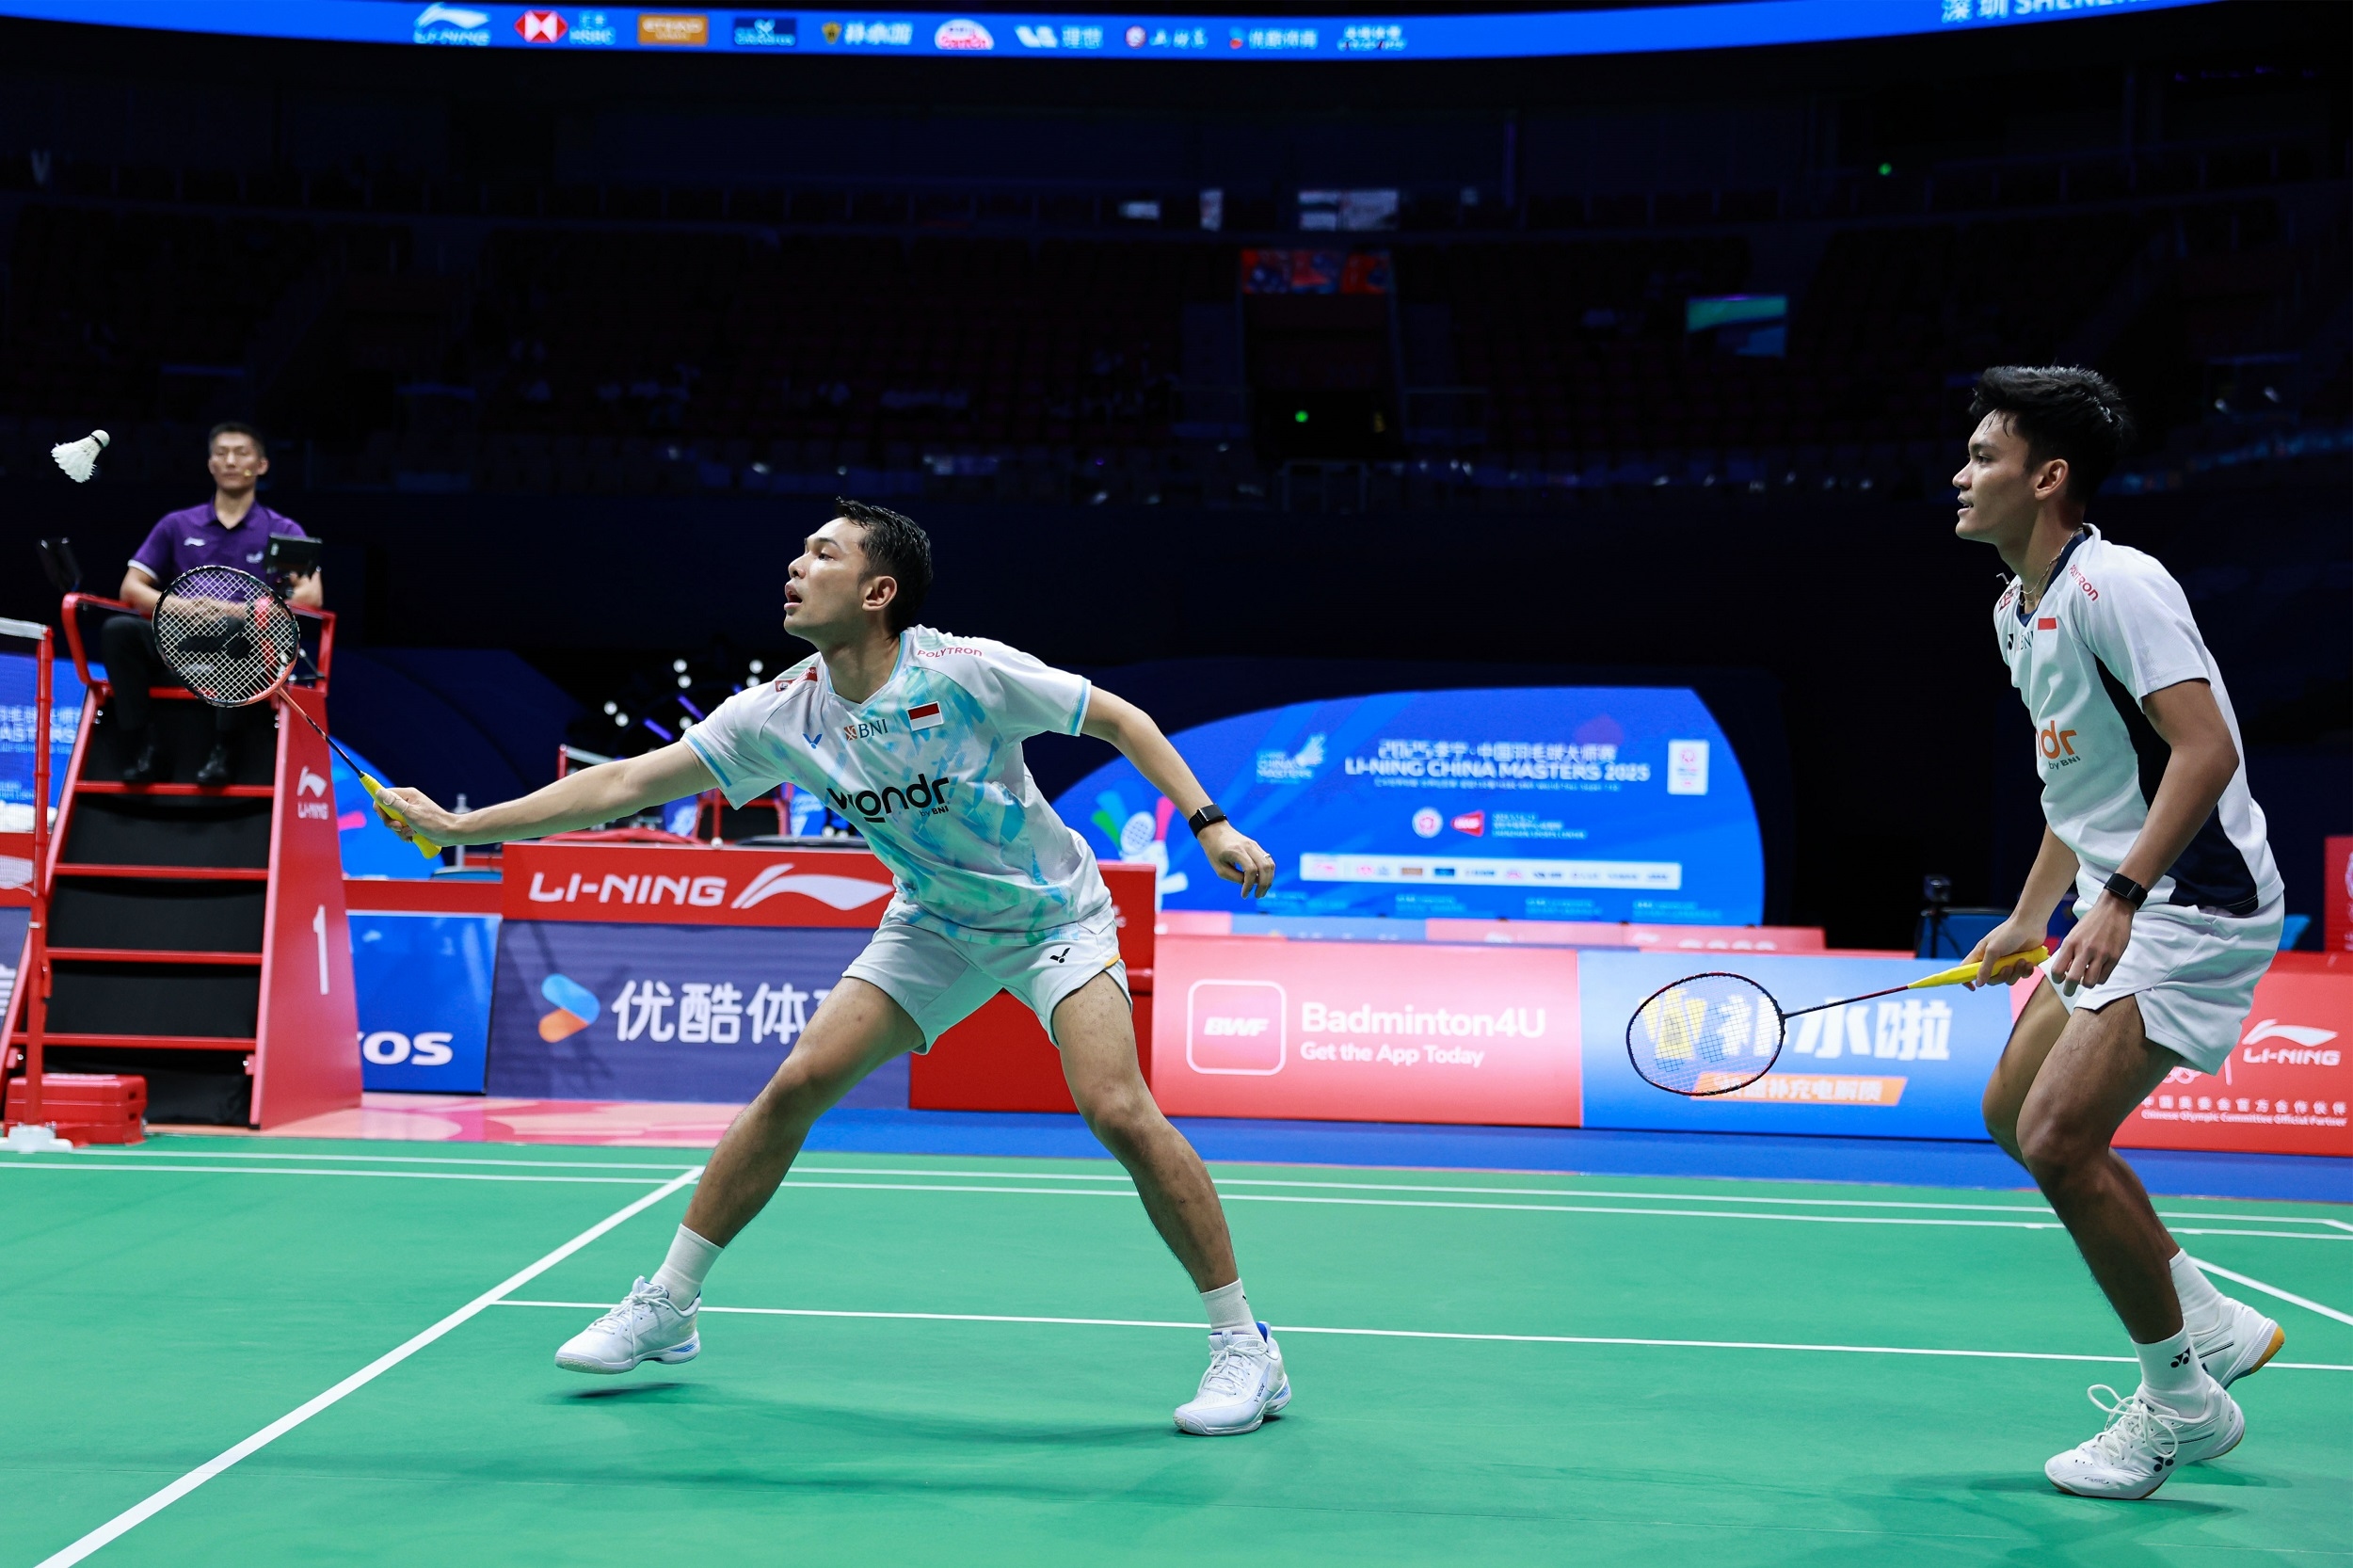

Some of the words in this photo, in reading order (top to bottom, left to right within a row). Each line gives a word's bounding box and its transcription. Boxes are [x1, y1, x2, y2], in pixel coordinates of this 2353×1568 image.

[917, 648, 983, 658] POLYTRON
[858, 719, 888, 738] BNI
[1344, 757, 1426, 776] LI-NING
[1427, 760, 1497, 778] CHINA
[1498, 761, 1602, 780] MASTERS
[1604, 762, 1651, 781] 2025
[2048, 761, 2059, 770] by
[2060, 756, 2081, 766] BNI
[826, 774, 949, 823] wondr
[920, 808, 931, 817] by
[932, 806, 949, 815] BNI
[529, 872, 728, 906] LI-NING
[312, 904, 328, 995] 1
[611, 980, 832, 1045] 优酷体
[1301, 1001, 1545, 1039] Badminton4U
[1203, 1016, 1270, 1037] BWF
[357, 1032, 454, 1065] OS
[1300, 1041, 1337, 1062] Get
[1340, 1044, 1372, 1063] the
[1375, 1044, 1419, 1066] App
[1423, 1046, 1484, 1067] Today
[2243, 1048, 2341, 1066] LI-NING
[2141, 1109, 2179, 1121] Chinese
[2179, 1111, 2220, 1123] Olympic
[2220, 1112, 2273, 1125] Committee
[2273, 1113, 2309, 1126] Official
[2309, 1115, 2348, 1128] Partner
